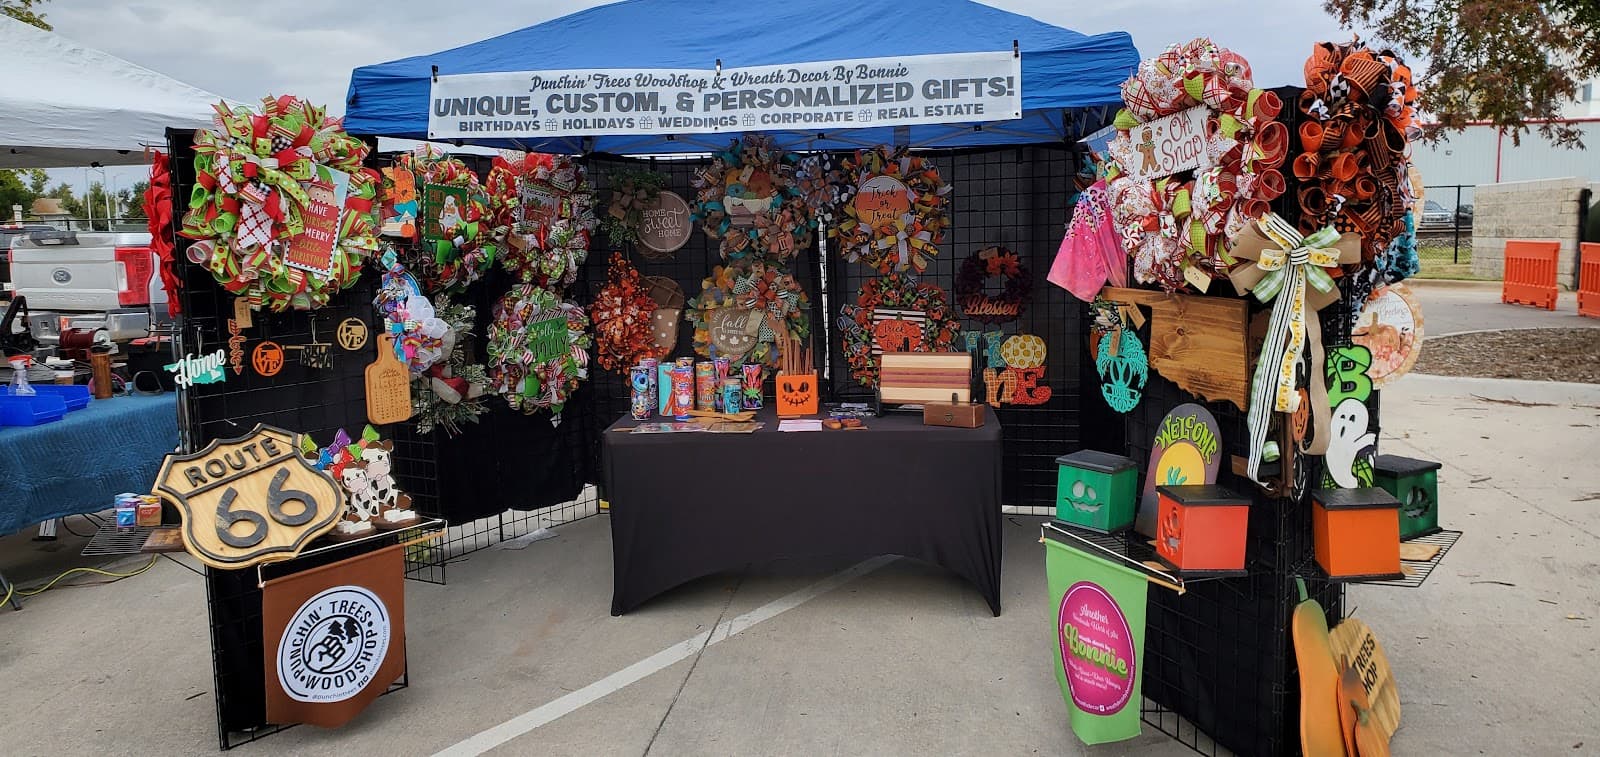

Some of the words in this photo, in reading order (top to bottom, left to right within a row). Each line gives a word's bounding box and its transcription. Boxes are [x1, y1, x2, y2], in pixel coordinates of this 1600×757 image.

[434, 95, 538, 118] UNIQUE,
[545, 91, 667, 115] CUSTOM,
[675, 92, 695, 112] &
[703, 82, 915, 112] PERSONALIZED
[921, 76, 1015, 100] GIFTS!
[529, 75, 592, 93] Punchin'
[590, 73, 632, 89] Trees
[635, 73, 709, 92] Woodshop
[711, 74, 726, 91] &
[731, 71, 786, 86] Wreath
[787, 69, 832, 84] Decor
[832, 66, 854, 83] By
[852, 62, 909, 79] Bonnie
[458, 120, 541, 132] BIRTHDAYS
[562, 117, 635, 130] HOLIDAYS
[658, 115, 738, 128] WEDDINGS
[760, 111, 854, 125] CORPORATE
[877, 107, 919, 120] REAL
[924, 103, 984, 117] ESTATE
[309, 204, 329, 217] HAVE
[642, 208, 667, 218] HOME
[304, 227, 331, 243] MERRY
[658, 229, 682, 238] HOME
[172, 348, 227, 389] Home
[1155, 413, 1218, 466] WELCOME
[184, 437, 281, 488] ROUTE
[215, 466, 318, 549] 66
[329, 599, 372, 624] TREES
[305, 630, 378, 690] WOODSHOP
[1064, 623, 1128, 675] Bonnie
[1352, 633, 1376, 673] TREES
